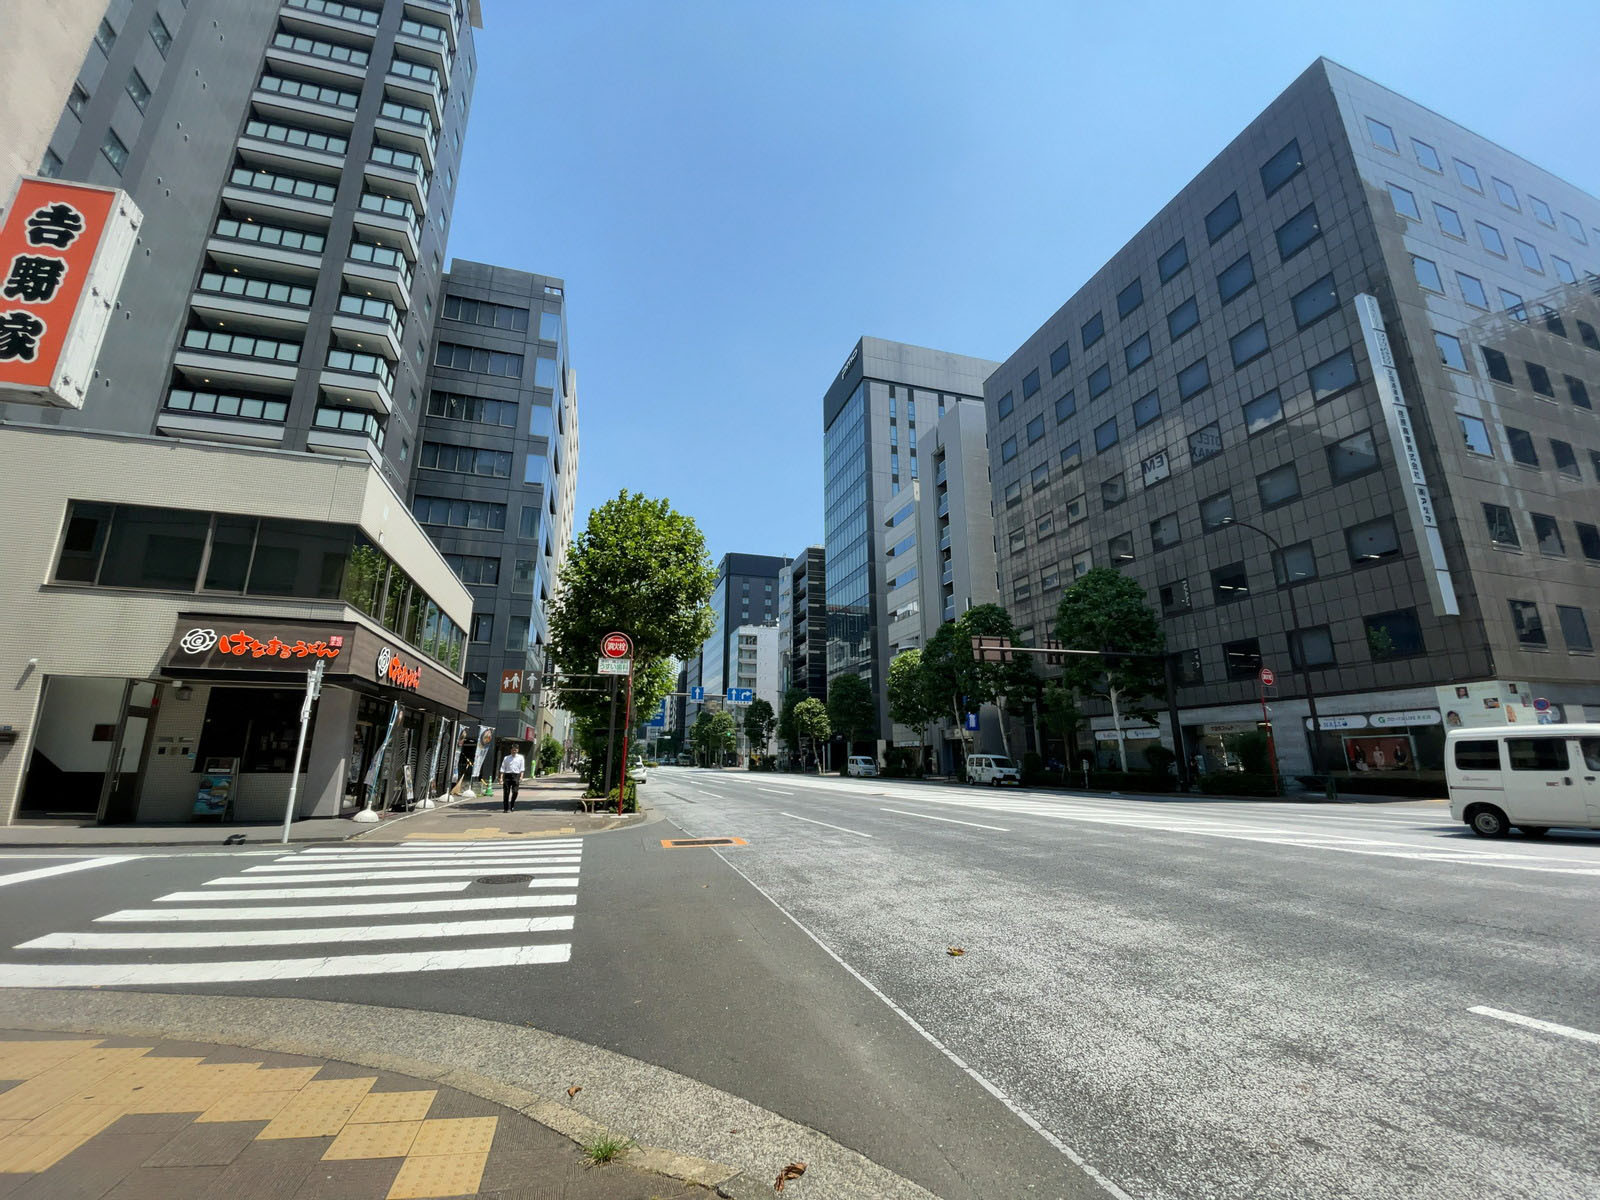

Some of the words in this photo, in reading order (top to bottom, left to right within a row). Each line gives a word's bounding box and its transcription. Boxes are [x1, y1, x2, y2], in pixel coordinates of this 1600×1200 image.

[0, 202, 86, 363] 吉野家
[218, 630, 339, 659] はなまるうどん
